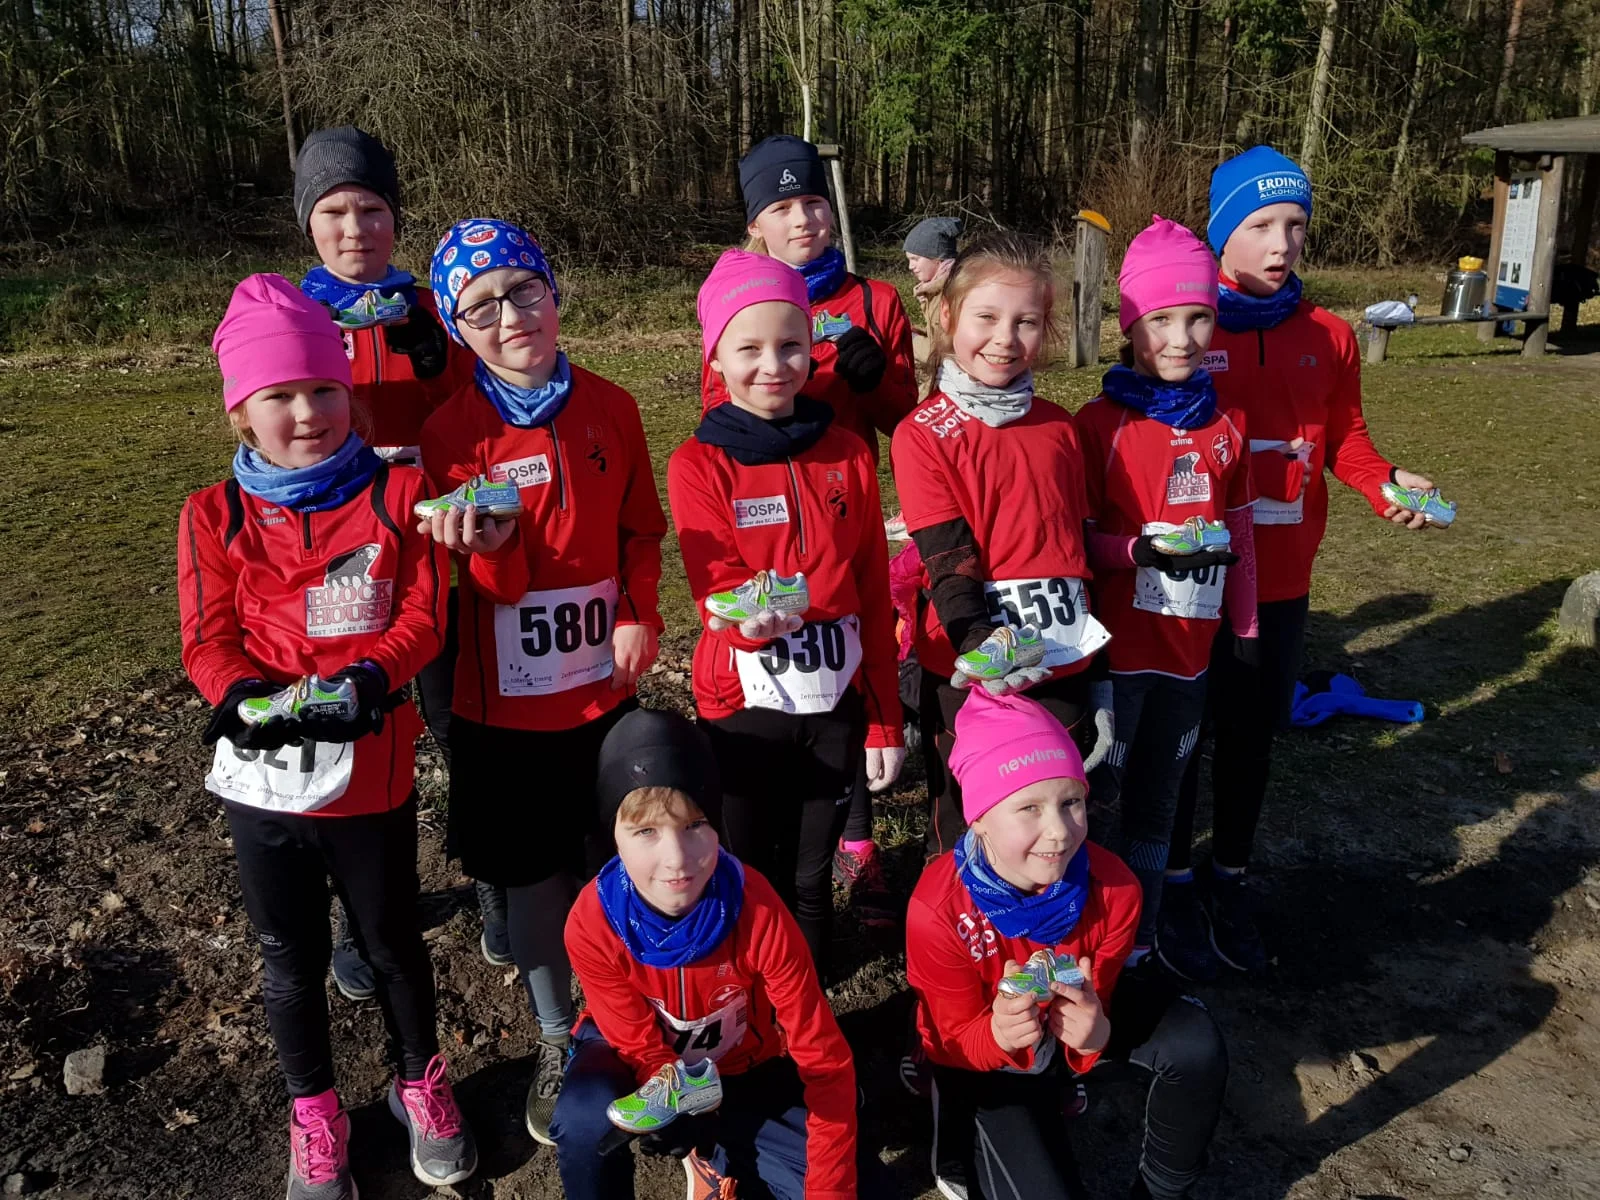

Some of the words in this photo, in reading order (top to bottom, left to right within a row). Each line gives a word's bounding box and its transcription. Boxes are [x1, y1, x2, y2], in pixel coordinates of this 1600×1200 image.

[508, 462, 547, 479] OSPA
[1168, 474, 1208, 488] BLOCK
[1168, 485, 1208, 498] HOUSE
[748, 502, 785, 517] OSPA
[308, 582, 391, 607] BLOCK
[985, 577, 1076, 631] 553
[308, 601, 389, 627] HOUSE
[520, 597, 607, 657] 580
[758, 624, 846, 676] 530
[998, 748, 1067, 777] newline
